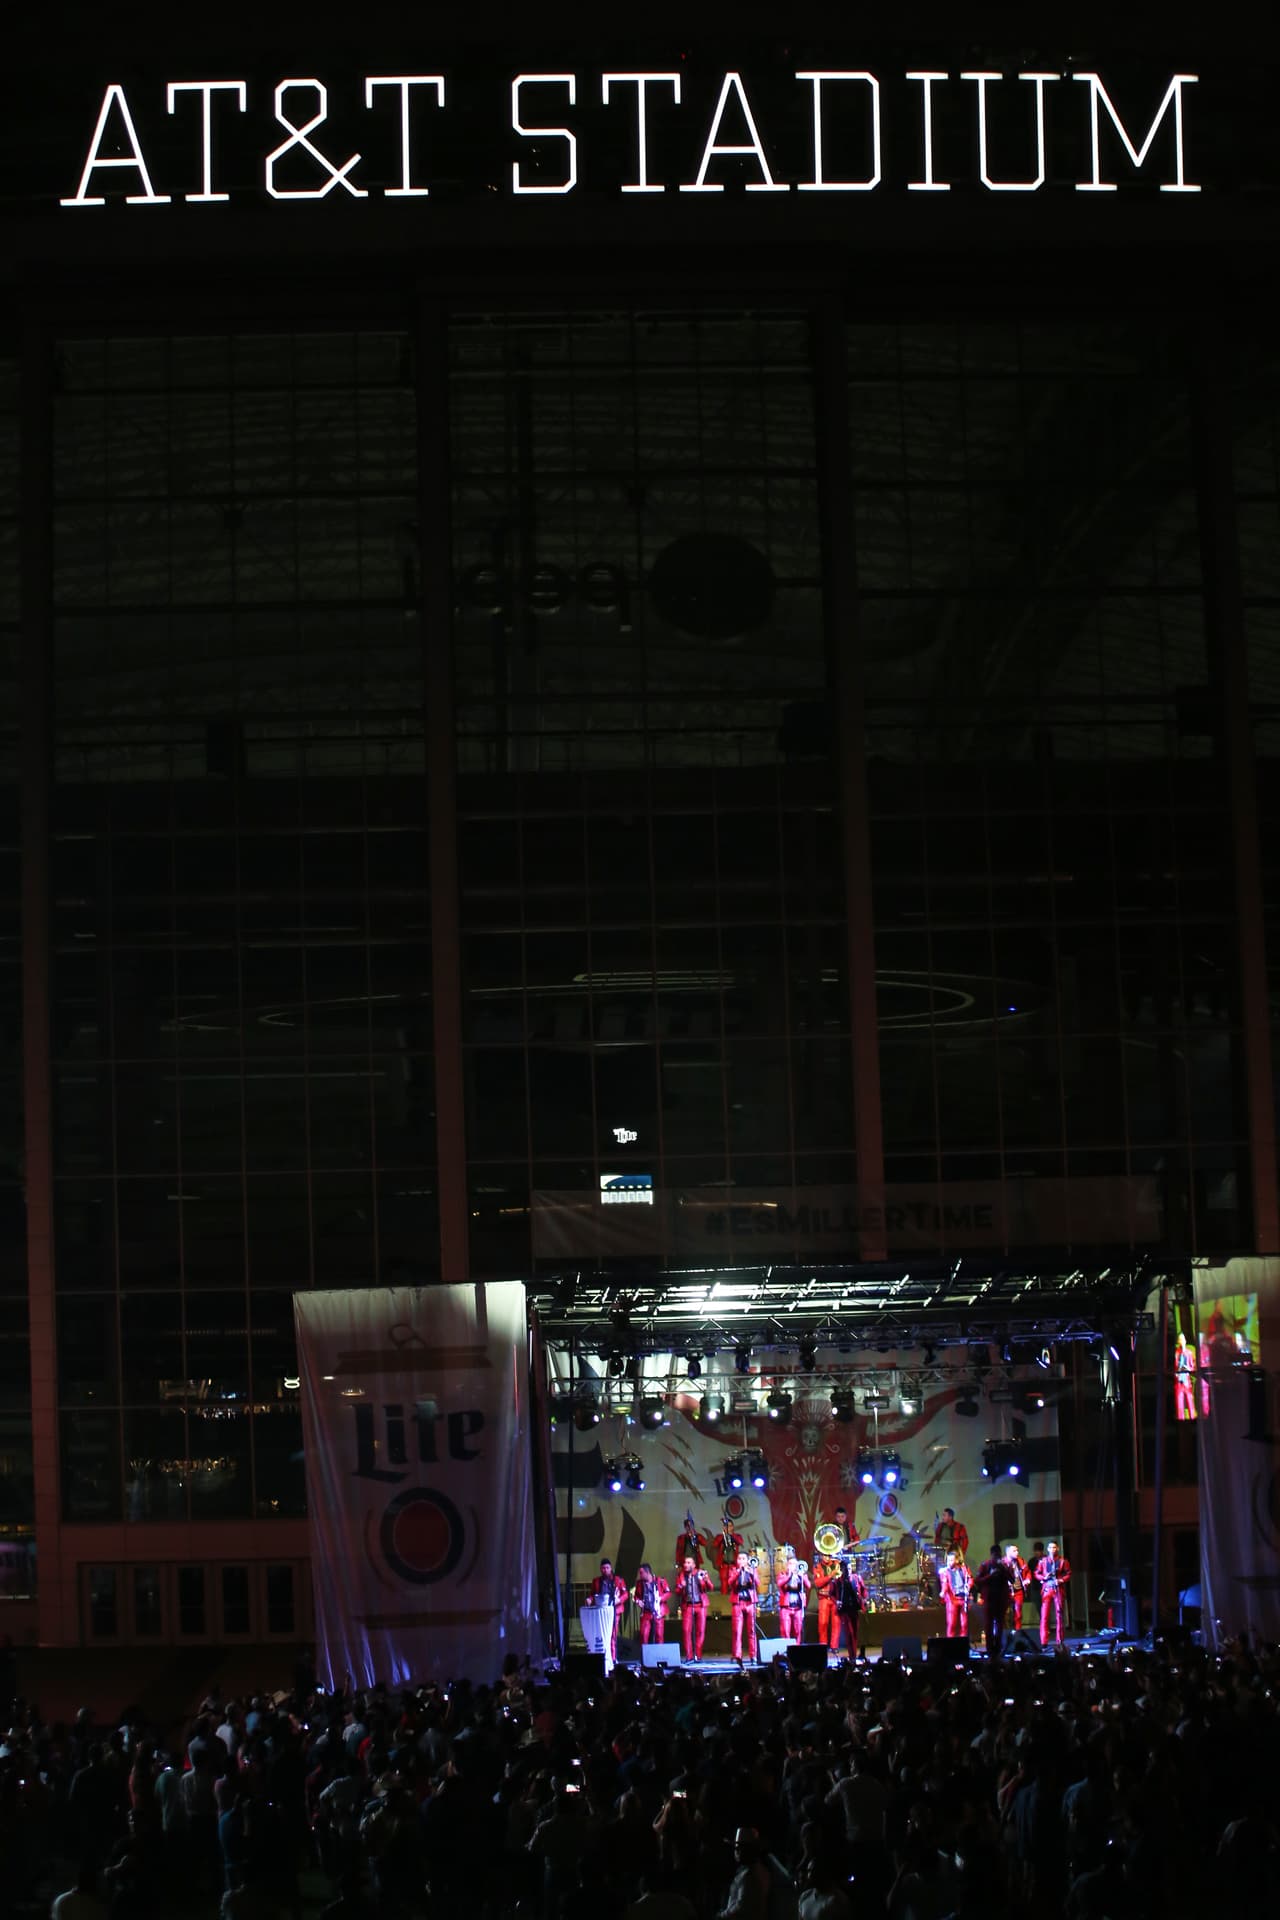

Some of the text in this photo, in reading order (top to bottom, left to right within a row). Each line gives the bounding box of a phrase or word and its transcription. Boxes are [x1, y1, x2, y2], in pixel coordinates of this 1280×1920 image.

[60, 70, 1202, 207] AT&T STADIUM
[351, 1402, 485, 1484] Lite
